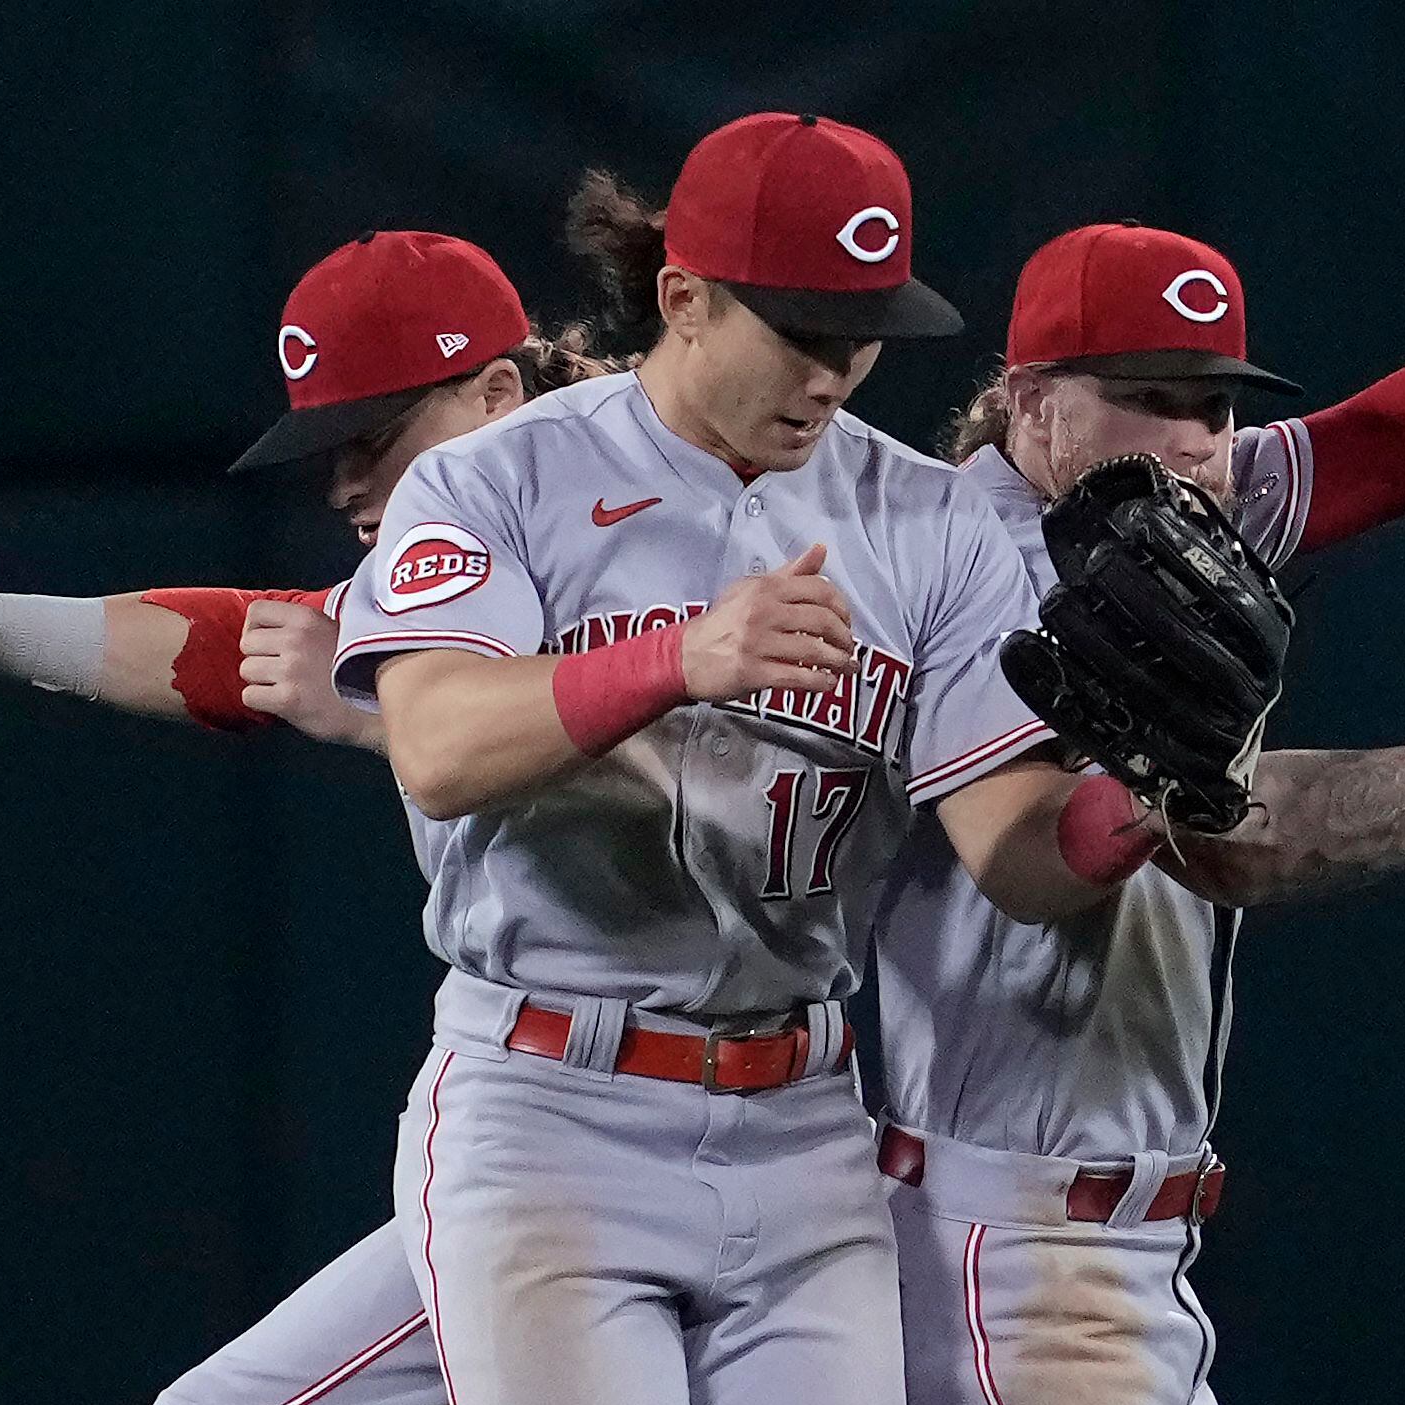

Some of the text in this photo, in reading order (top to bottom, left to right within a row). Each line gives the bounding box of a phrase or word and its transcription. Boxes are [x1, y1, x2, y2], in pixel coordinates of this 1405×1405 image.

[836, 206, 899, 263] C
[1162, 270, 1228, 322] C
[279, 325, 318, 380] C
[391, 553, 488, 590] REDS
[759, 767, 871, 900] 17
